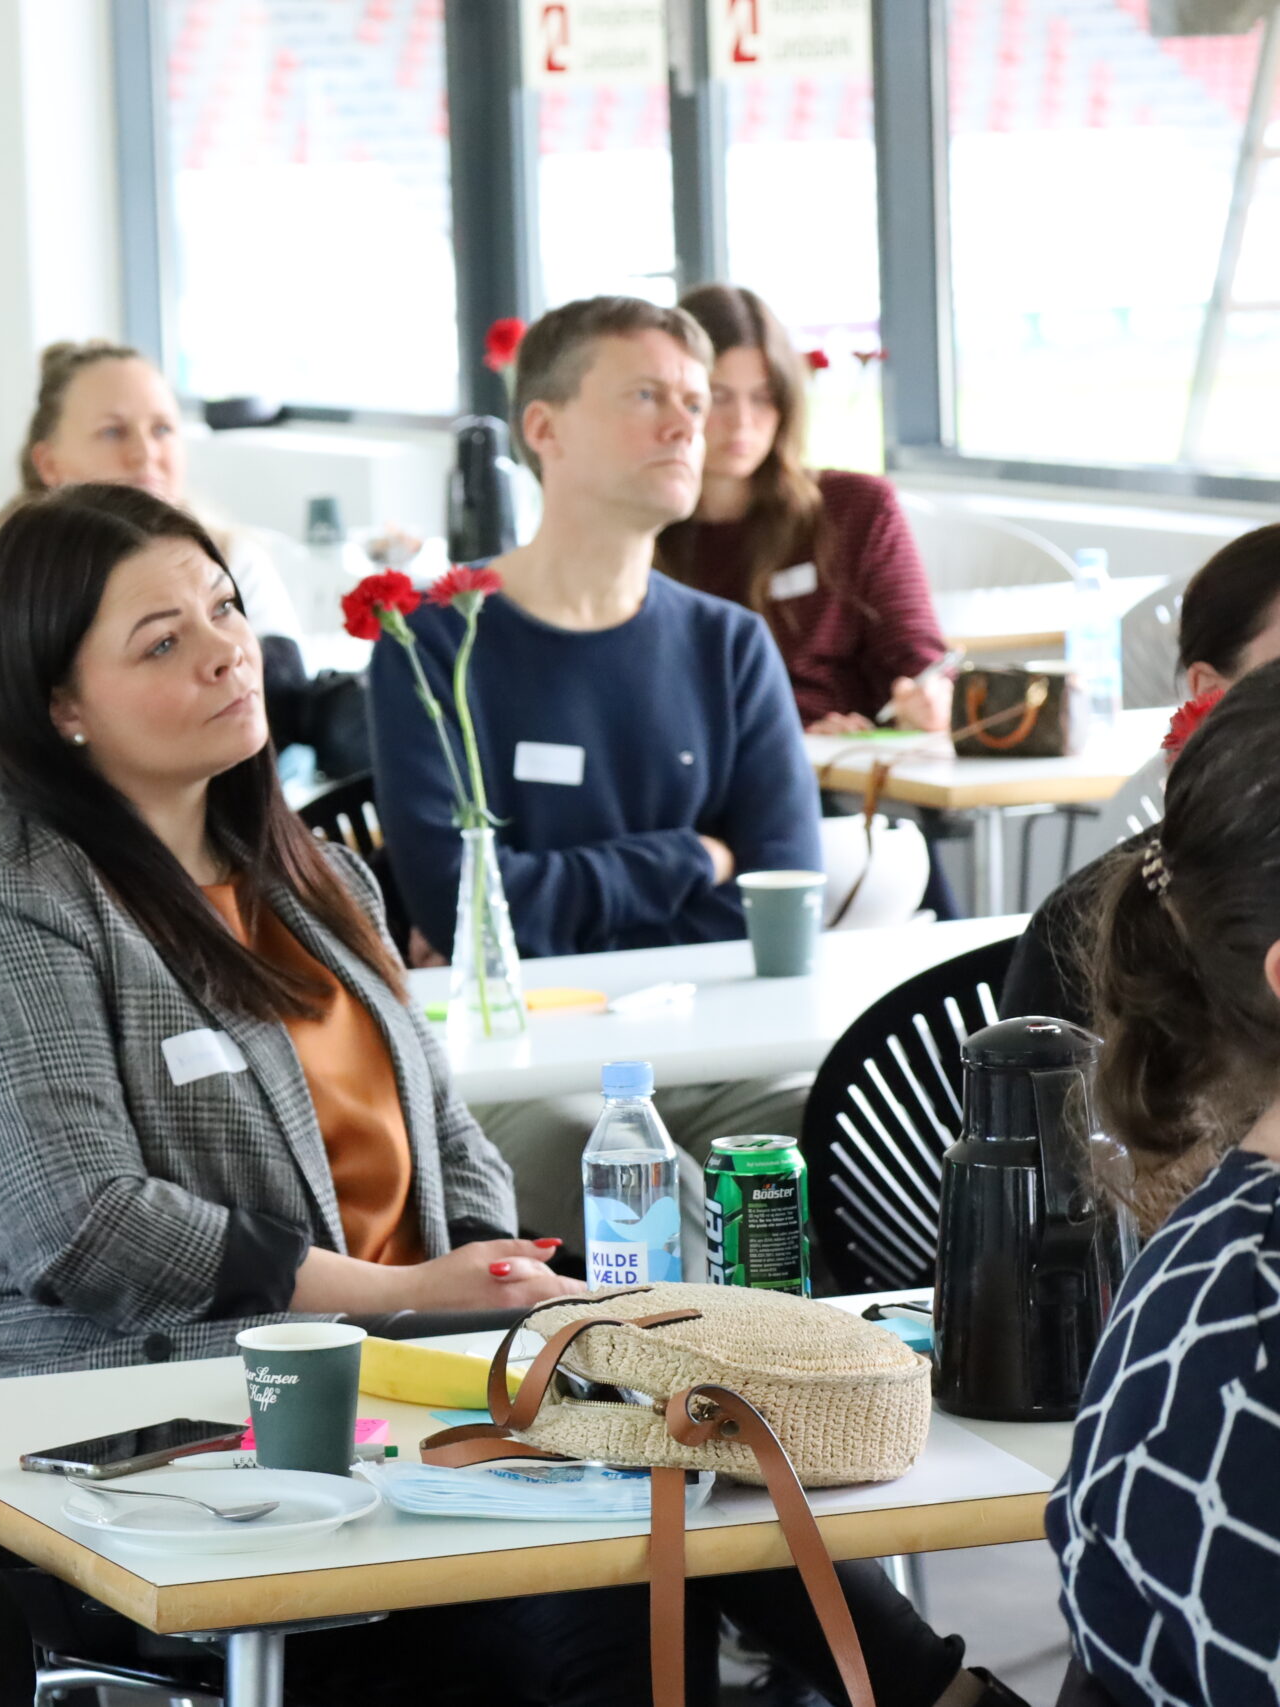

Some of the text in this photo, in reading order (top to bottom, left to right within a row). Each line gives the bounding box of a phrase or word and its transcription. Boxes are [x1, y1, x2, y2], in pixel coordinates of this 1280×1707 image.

[752, 1187, 795, 1200] Booster
[592, 1252, 639, 1268] KILDE
[255, 1366, 300, 1384] Larsen
[250, 1383, 278, 1412] Kaffe
[232, 1456, 255, 1464] LEA
